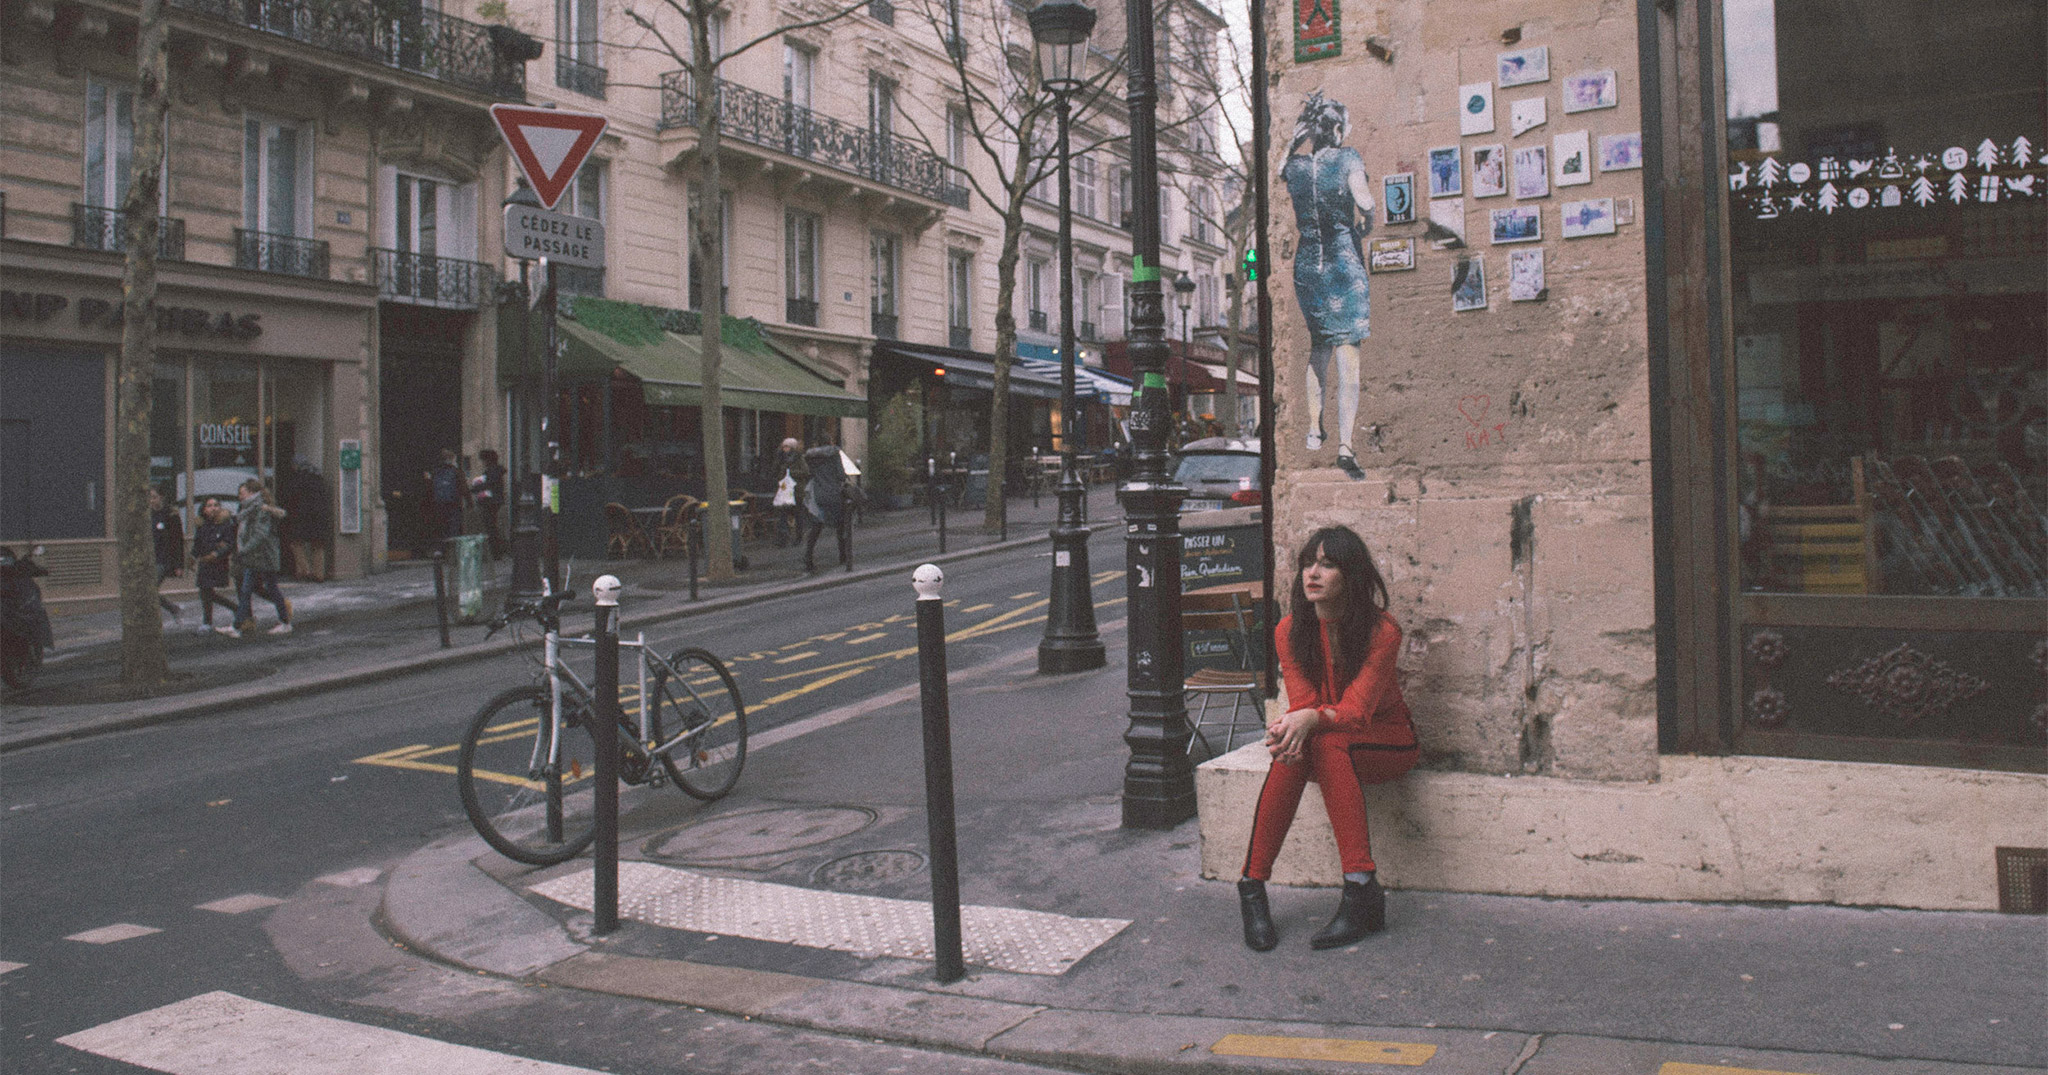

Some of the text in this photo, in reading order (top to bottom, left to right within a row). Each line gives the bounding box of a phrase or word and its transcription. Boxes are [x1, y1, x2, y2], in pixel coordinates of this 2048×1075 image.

[521, 214, 592, 241] CÉDEZ LE
[524, 236, 589, 259] PASSAGE
[79, 297, 263, 341] PAIBAS
[200, 423, 252, 444] CONSEIL
